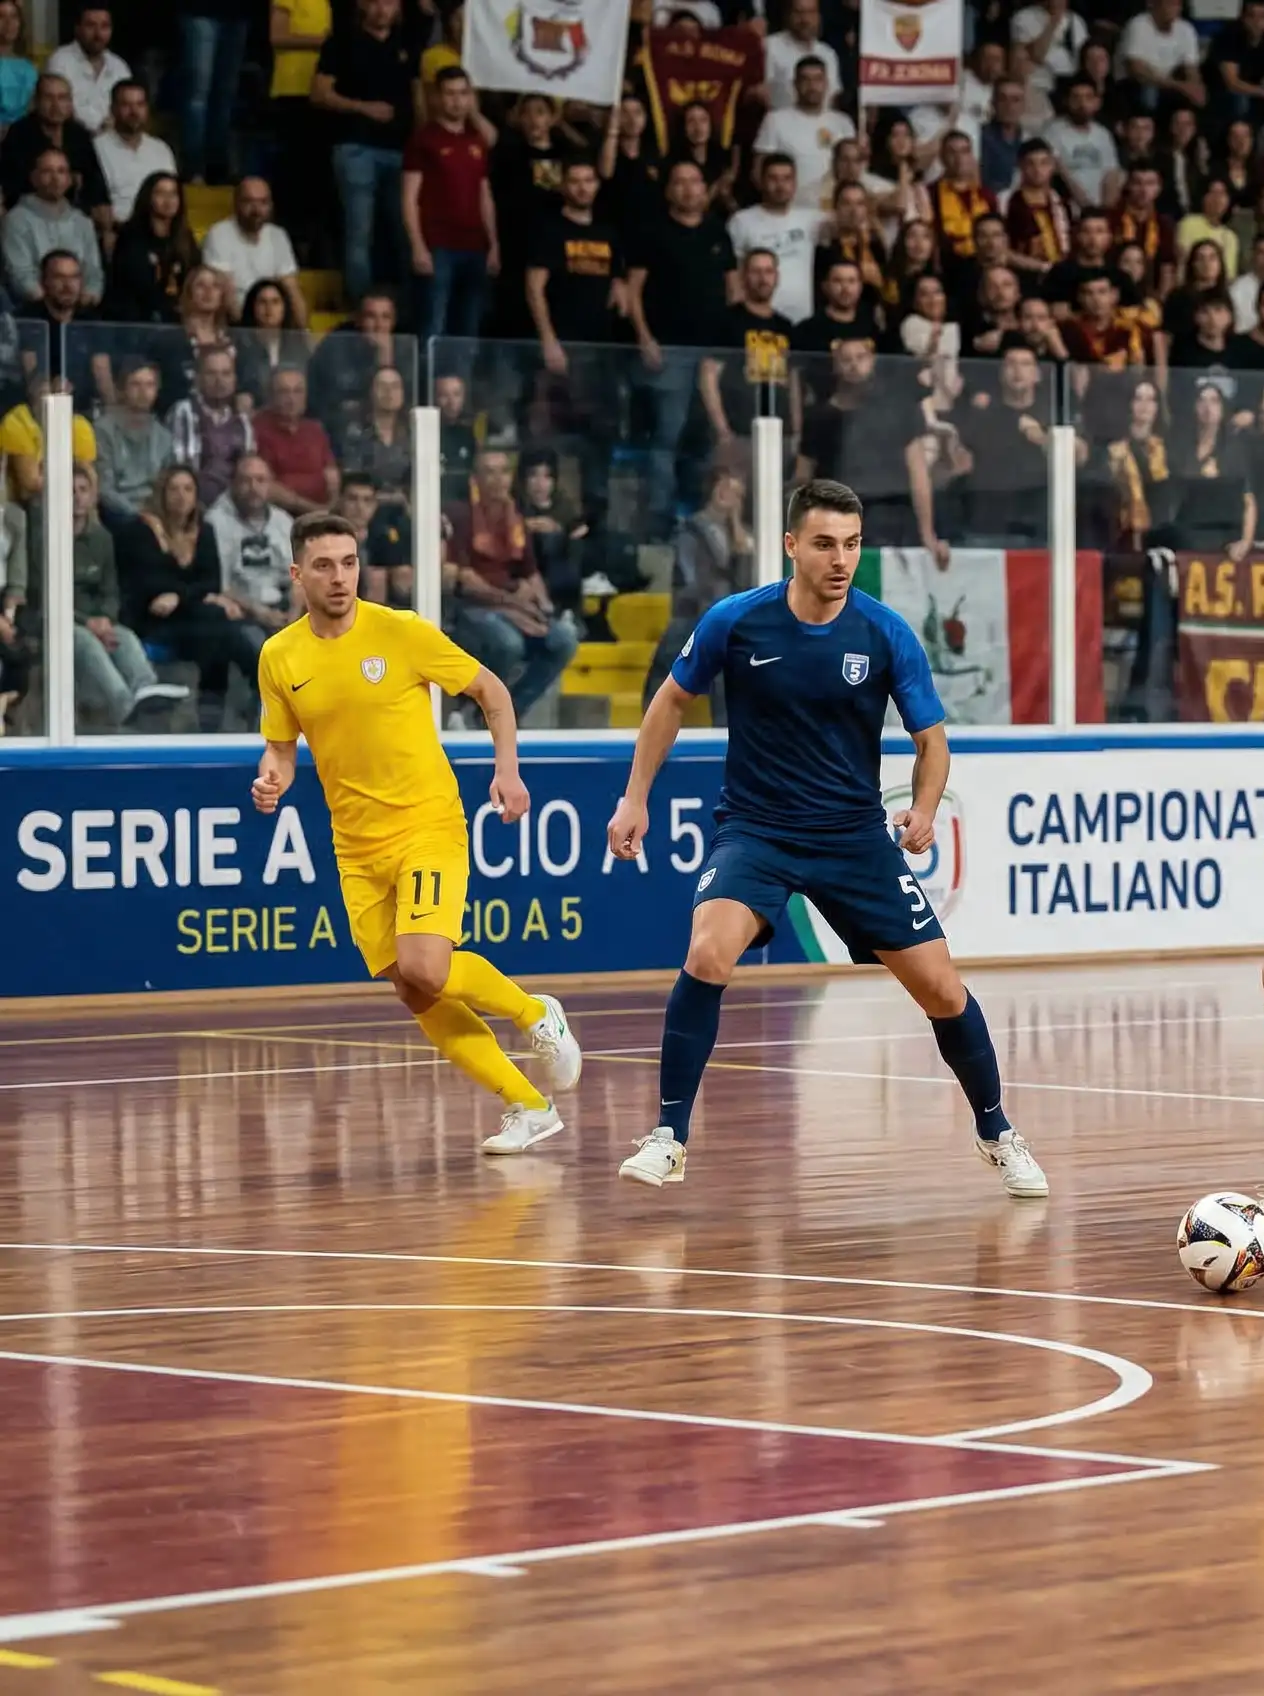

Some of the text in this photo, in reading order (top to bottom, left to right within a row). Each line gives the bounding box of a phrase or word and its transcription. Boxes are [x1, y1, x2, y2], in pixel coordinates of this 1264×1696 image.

[1185, 560, 1244, 618] A.S.
[850, 663, 861, 680] 5
[17, 806, 242, 892] SERIE
[262, 805, 316, 885] A
[670, 797, 704, 873] 5
[411, 870, 441, 906] 11
[897, 874, 926, 912] 5
[1009, 858, 1221, 915] ITALIANO
[177, 906, 337, 954] SERIE A
[522, 898, 549, 941] A
[561, 896, 582, 940] 5
